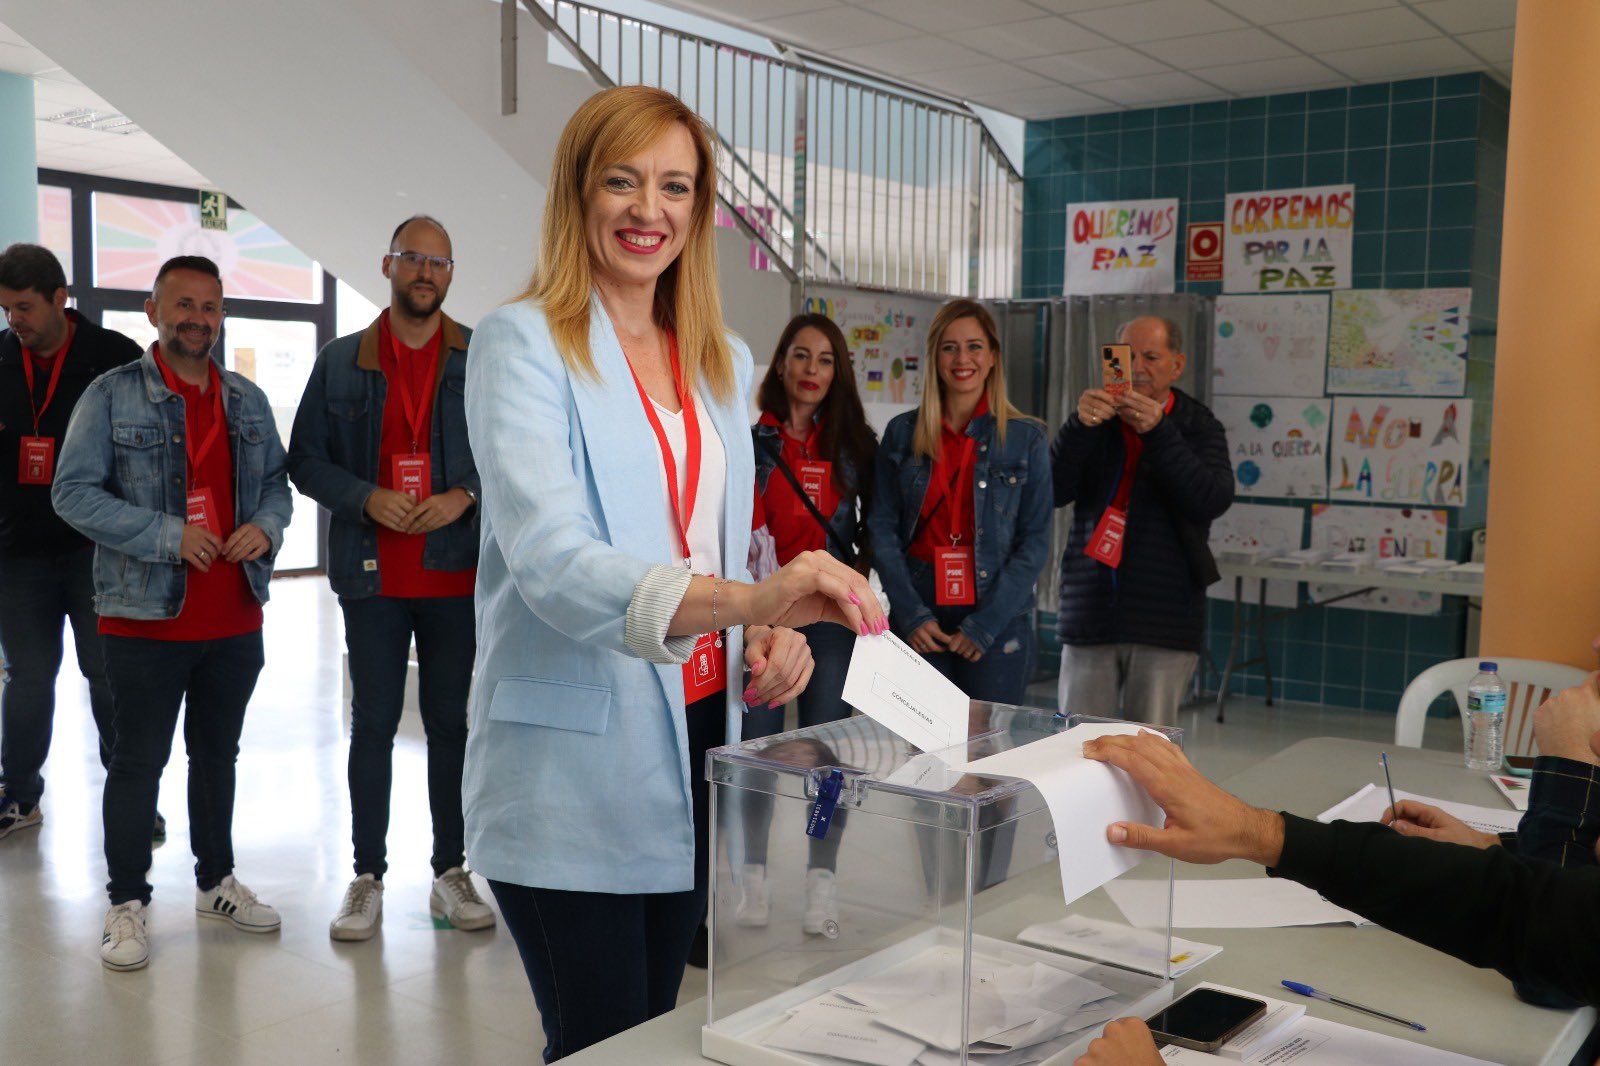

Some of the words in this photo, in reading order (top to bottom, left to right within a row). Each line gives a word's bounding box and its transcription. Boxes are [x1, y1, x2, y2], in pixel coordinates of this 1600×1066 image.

[1074, 206, 1174, 244] QUEREMOS
[1231, 191, 1355, 235] CORREMOS
[1092, 245, 1157, 270] PAZ
[1243, 240, 1290, 265] POR
[1300, 238, 1332, 262] LA
[1259, 266, 1336, 290] PAZ
[1331, 456, 1373, 497] LA
[1379, 536, 1407, 558] EN
